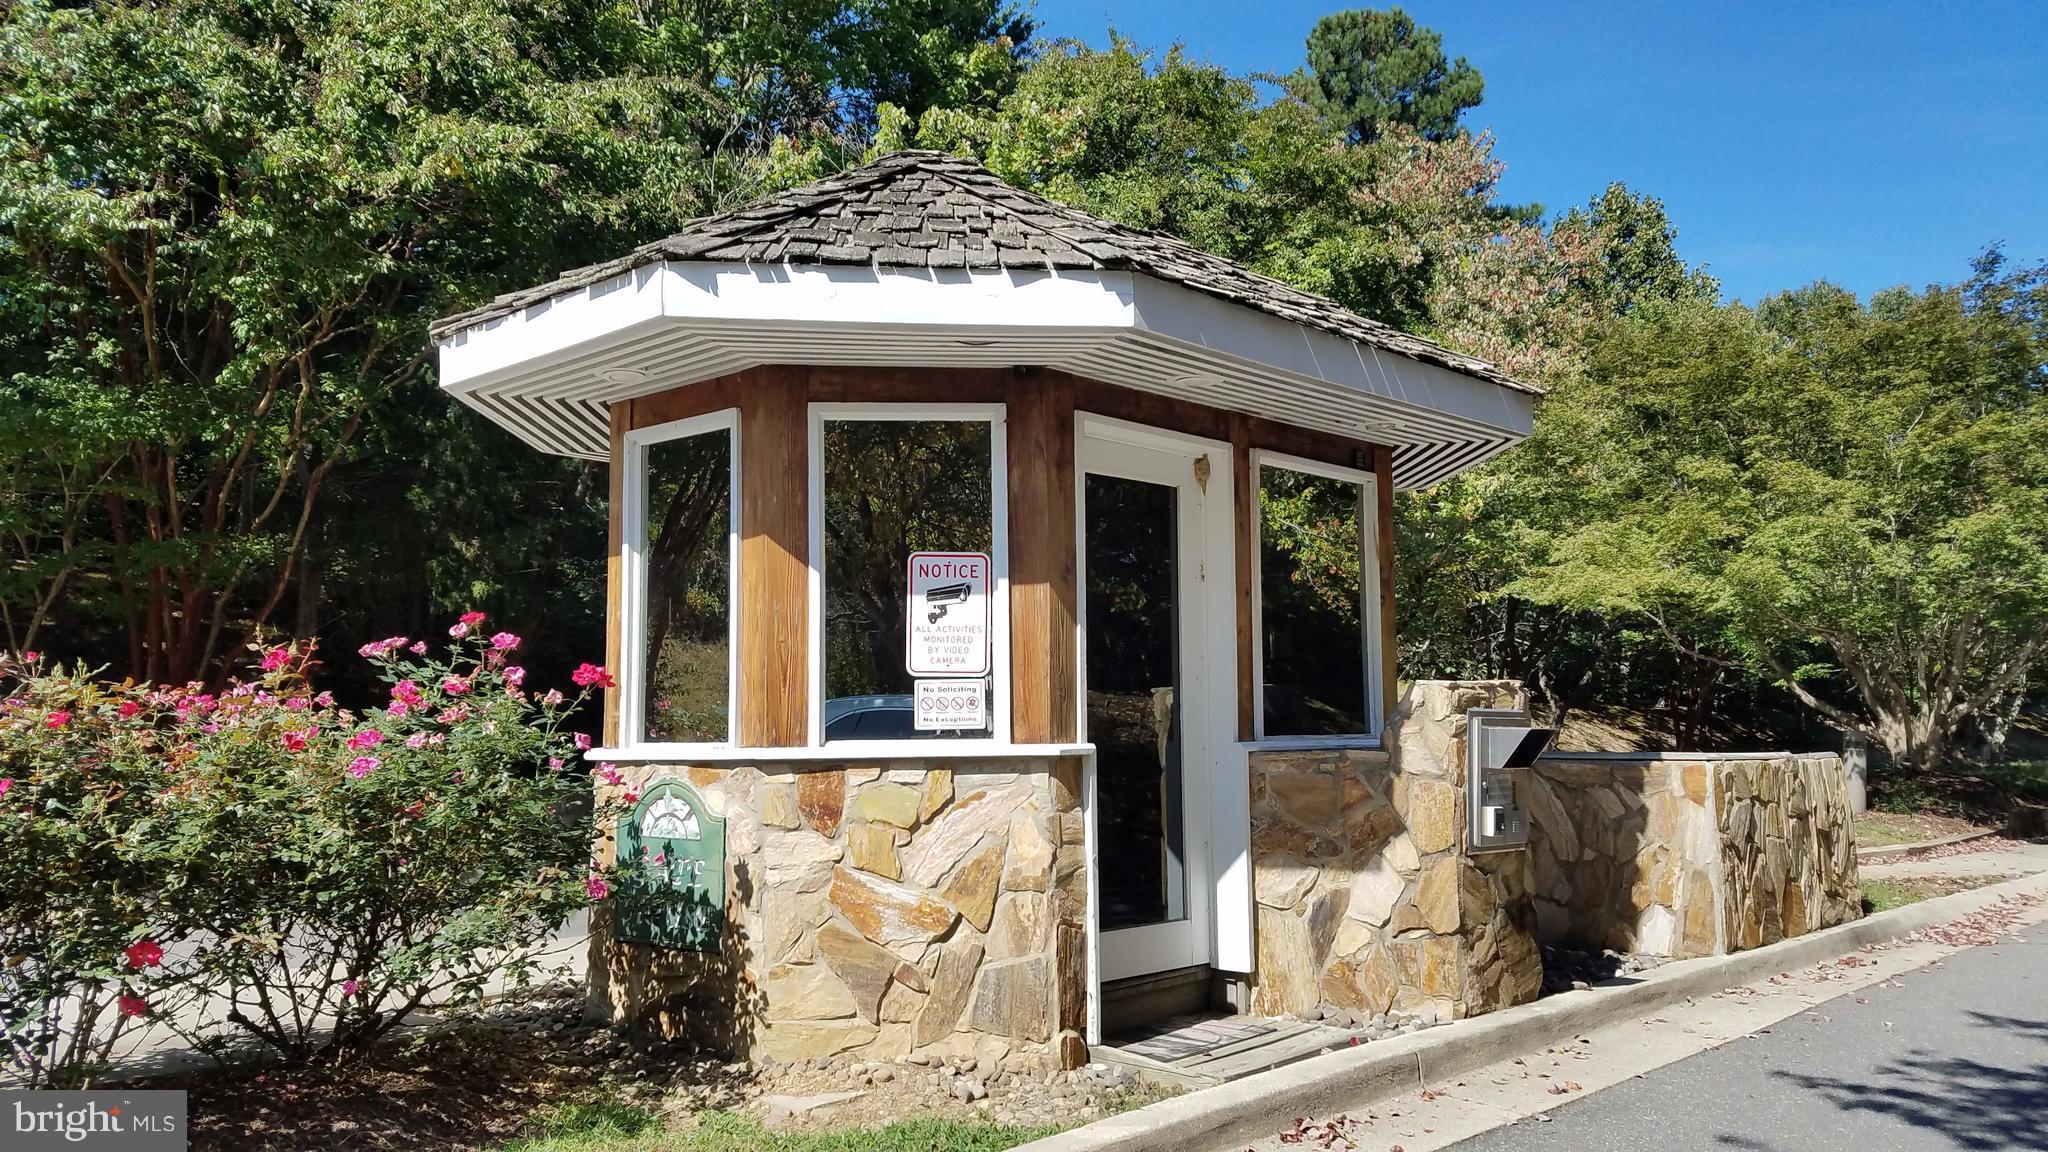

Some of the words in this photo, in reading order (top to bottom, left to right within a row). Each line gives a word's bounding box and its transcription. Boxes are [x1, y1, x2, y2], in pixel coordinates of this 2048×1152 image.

[919, 563, 979, 579] NOTICE
[915, 625, 932, 633] ALL
[936, 625, 983, 634] ACTIVITIES
[923, 635, 974, 644] MONITORED
[928, 646, 940, 654] BY
[944, 646, 970, 654] VIDEO
[937, 686, 977, 694] Soliciting
